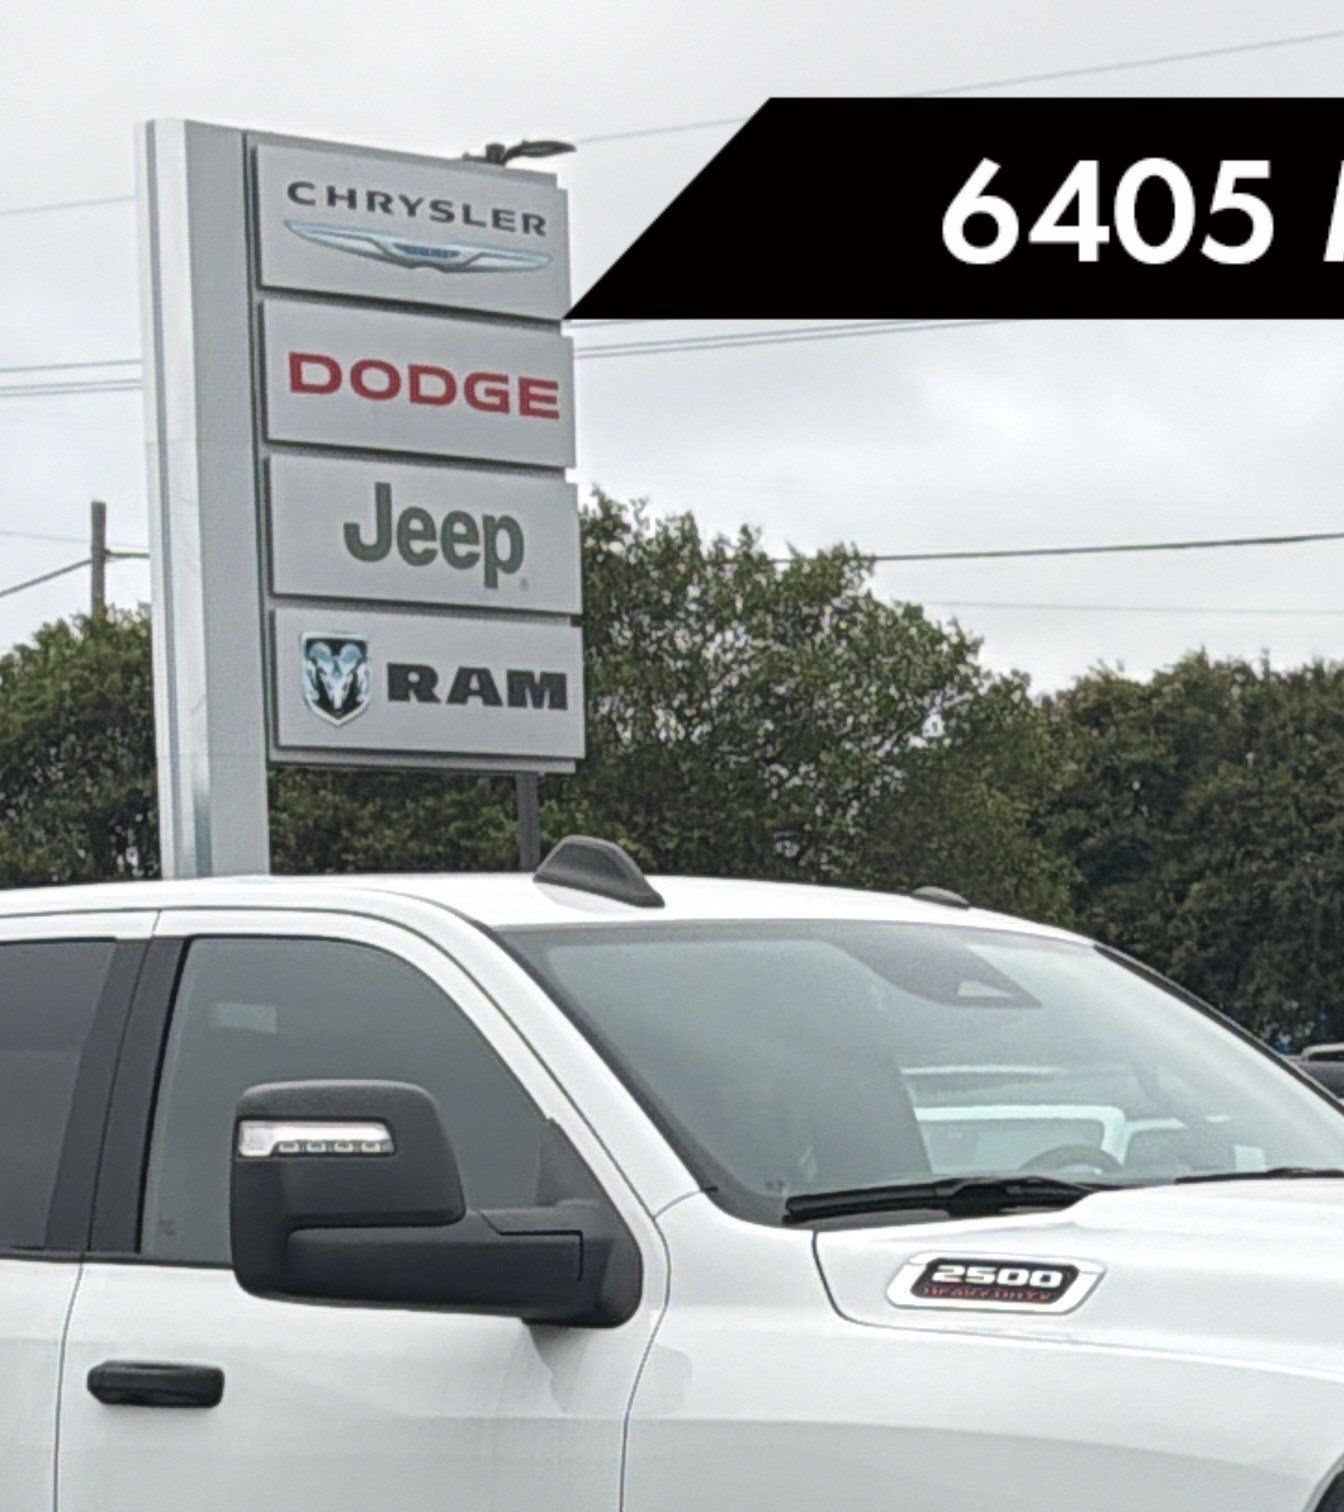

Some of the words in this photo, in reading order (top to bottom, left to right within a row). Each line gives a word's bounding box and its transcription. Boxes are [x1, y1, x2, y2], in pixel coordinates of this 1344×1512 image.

[287, 180, 548, 238] CHRYSLER
[289, 351, 560, 420] DODGE
[343, 481, 525, 590] Jeep
[387, 661, 569, 711] RAM
[931, 1264, 1063, 1288] 2500
